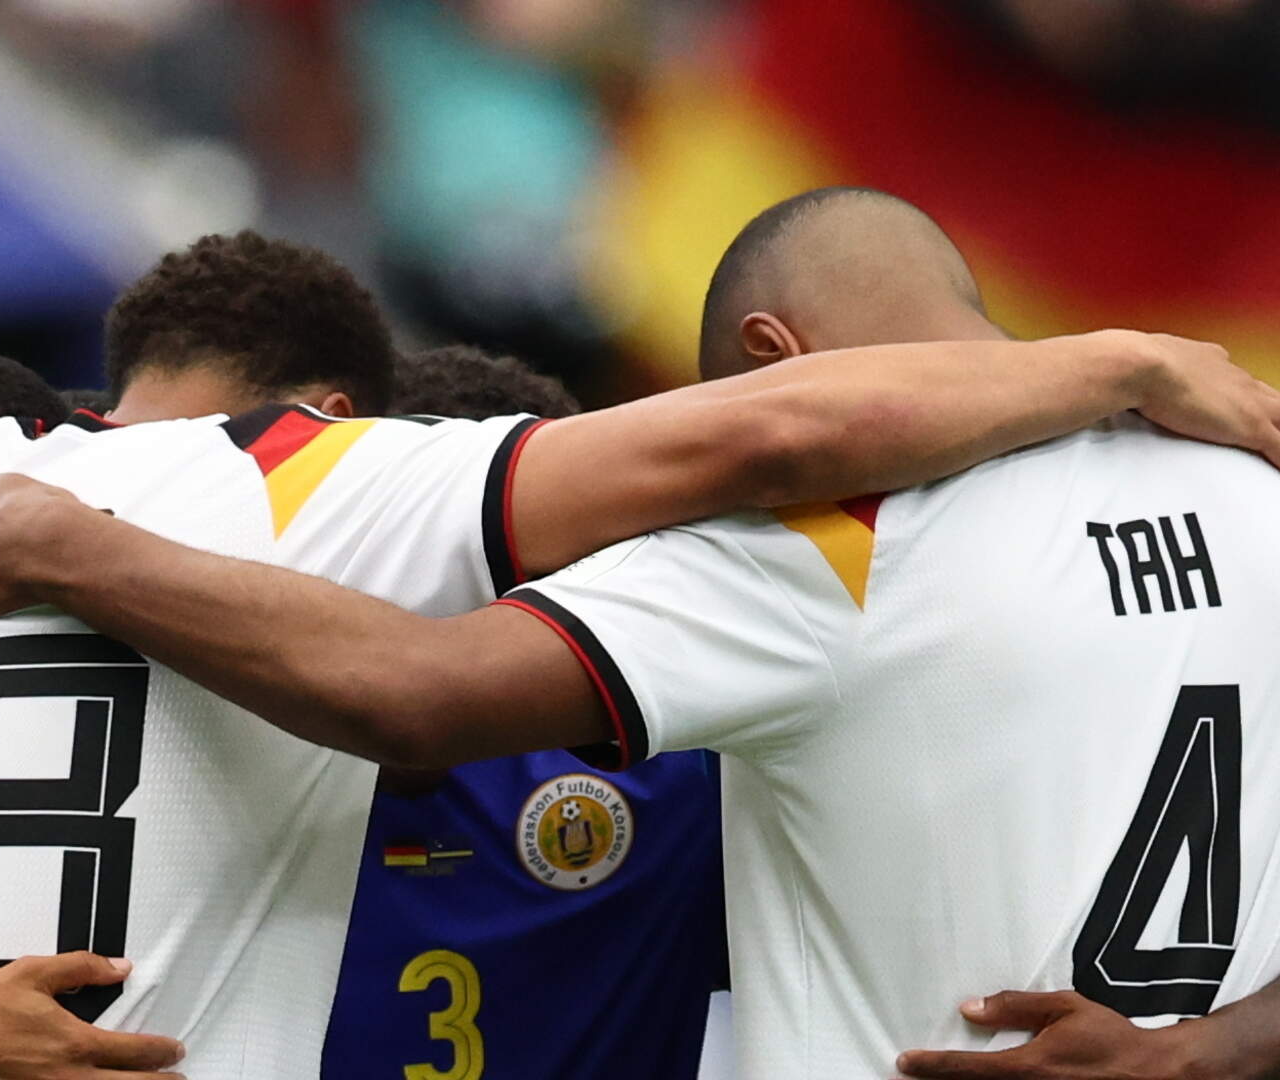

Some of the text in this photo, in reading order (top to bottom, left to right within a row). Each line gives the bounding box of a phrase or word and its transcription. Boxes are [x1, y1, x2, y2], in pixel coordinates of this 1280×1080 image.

[1086, 512, 1222, 616] TAH
[525, 793, 557, 882] Federashon
[556, 781, 611, 802] Futbol
[1072, 684, 1242, 1023] 4
